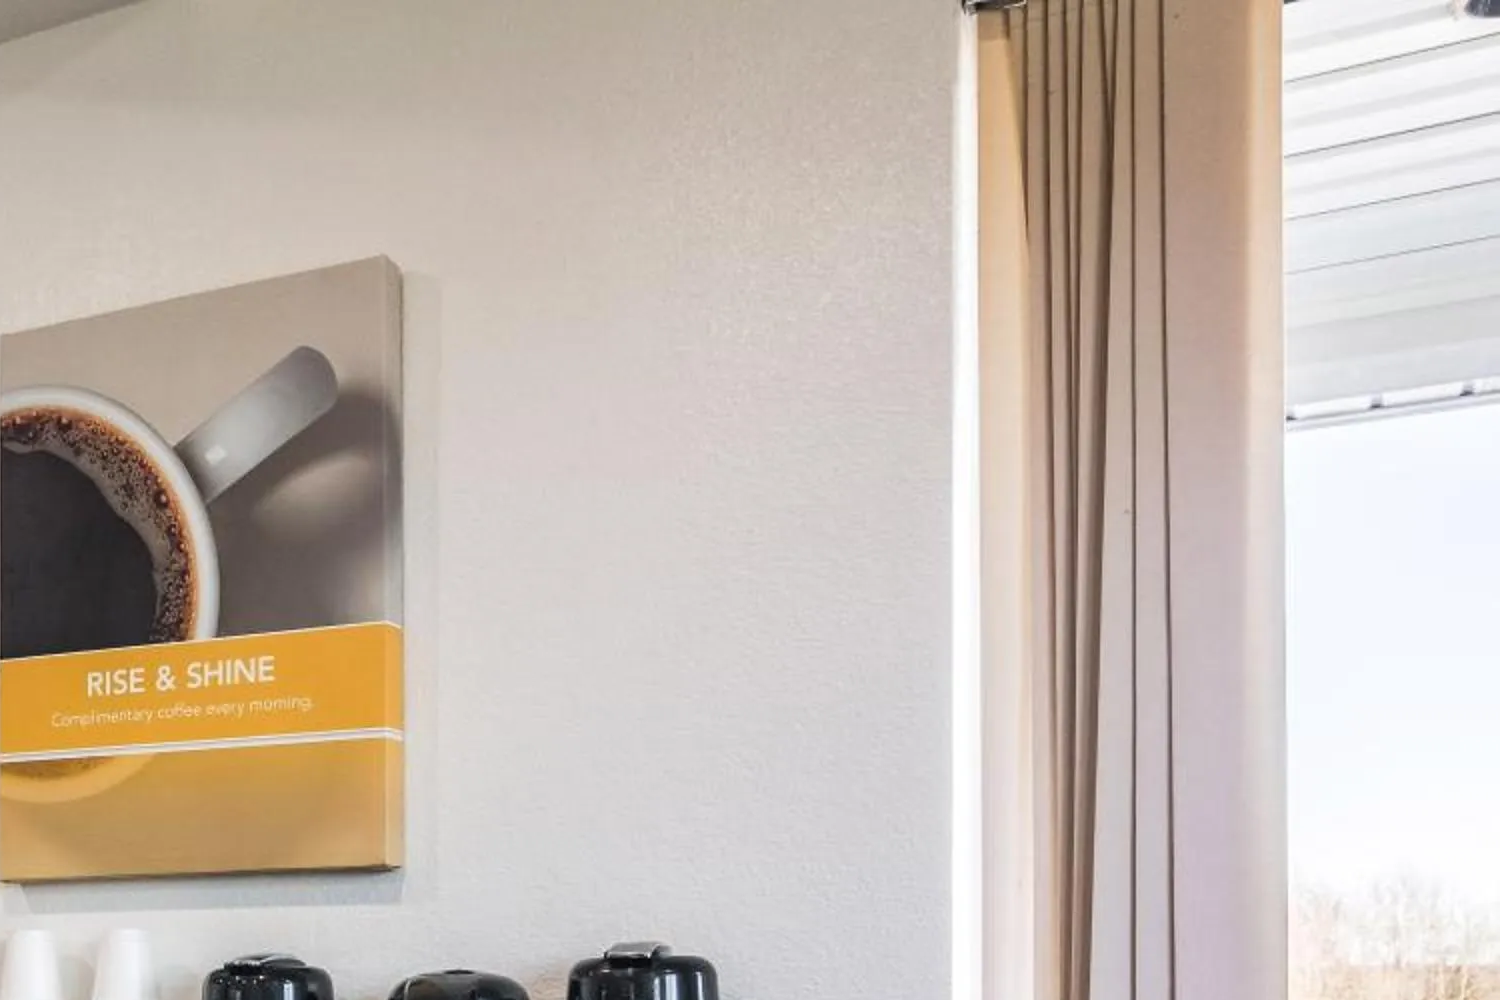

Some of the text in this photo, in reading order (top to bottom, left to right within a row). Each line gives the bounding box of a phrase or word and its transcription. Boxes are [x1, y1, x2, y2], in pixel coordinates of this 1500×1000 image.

[86, 655, 276, 698] RISE & SHINE
[51, 708, 154, 728] Complimentary
[157, 702, 202, 720] coffee
[205, 703, 245, 719] every
